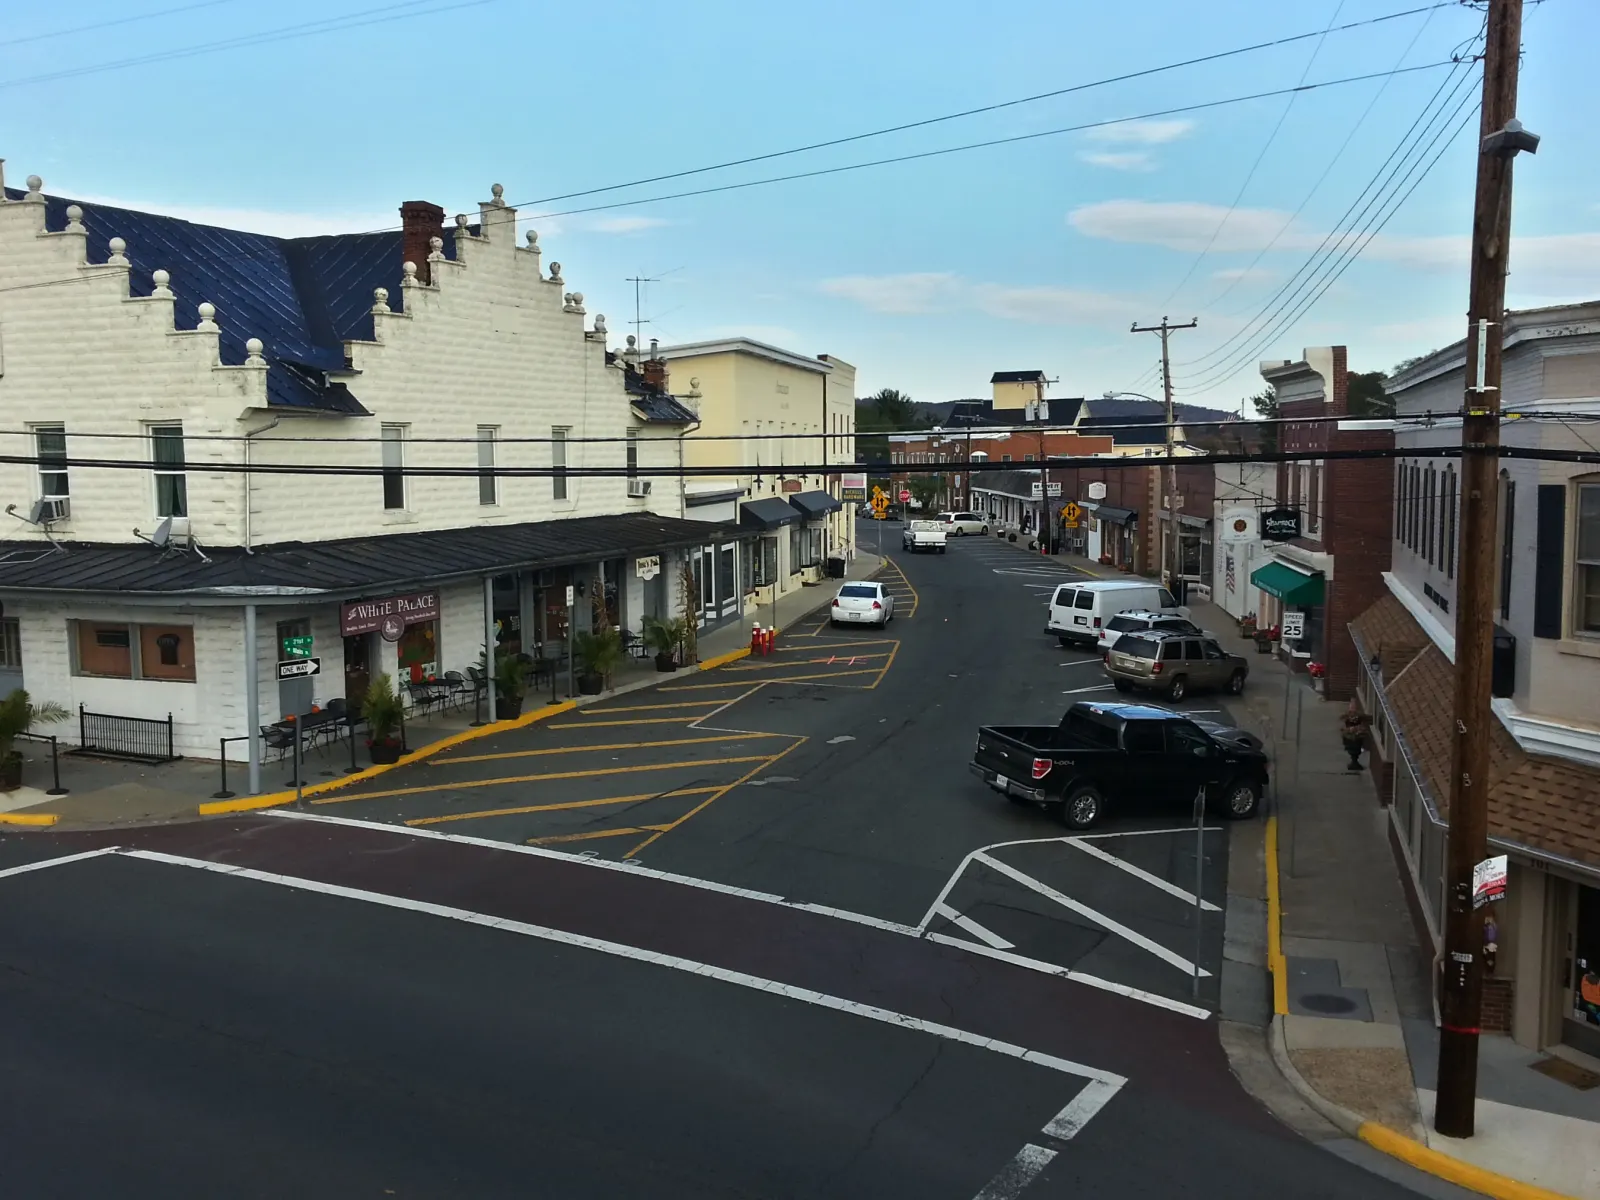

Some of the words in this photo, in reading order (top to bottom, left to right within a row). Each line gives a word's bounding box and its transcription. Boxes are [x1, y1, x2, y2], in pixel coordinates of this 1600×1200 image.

[357, 601, 392, 619] WHITE
[397, 594, 434, 612] PALACE
[1283, 625, 1301, 636] 25
[282, 666, 295, 674] ONE
[296, 664, 308, 672] WAY
